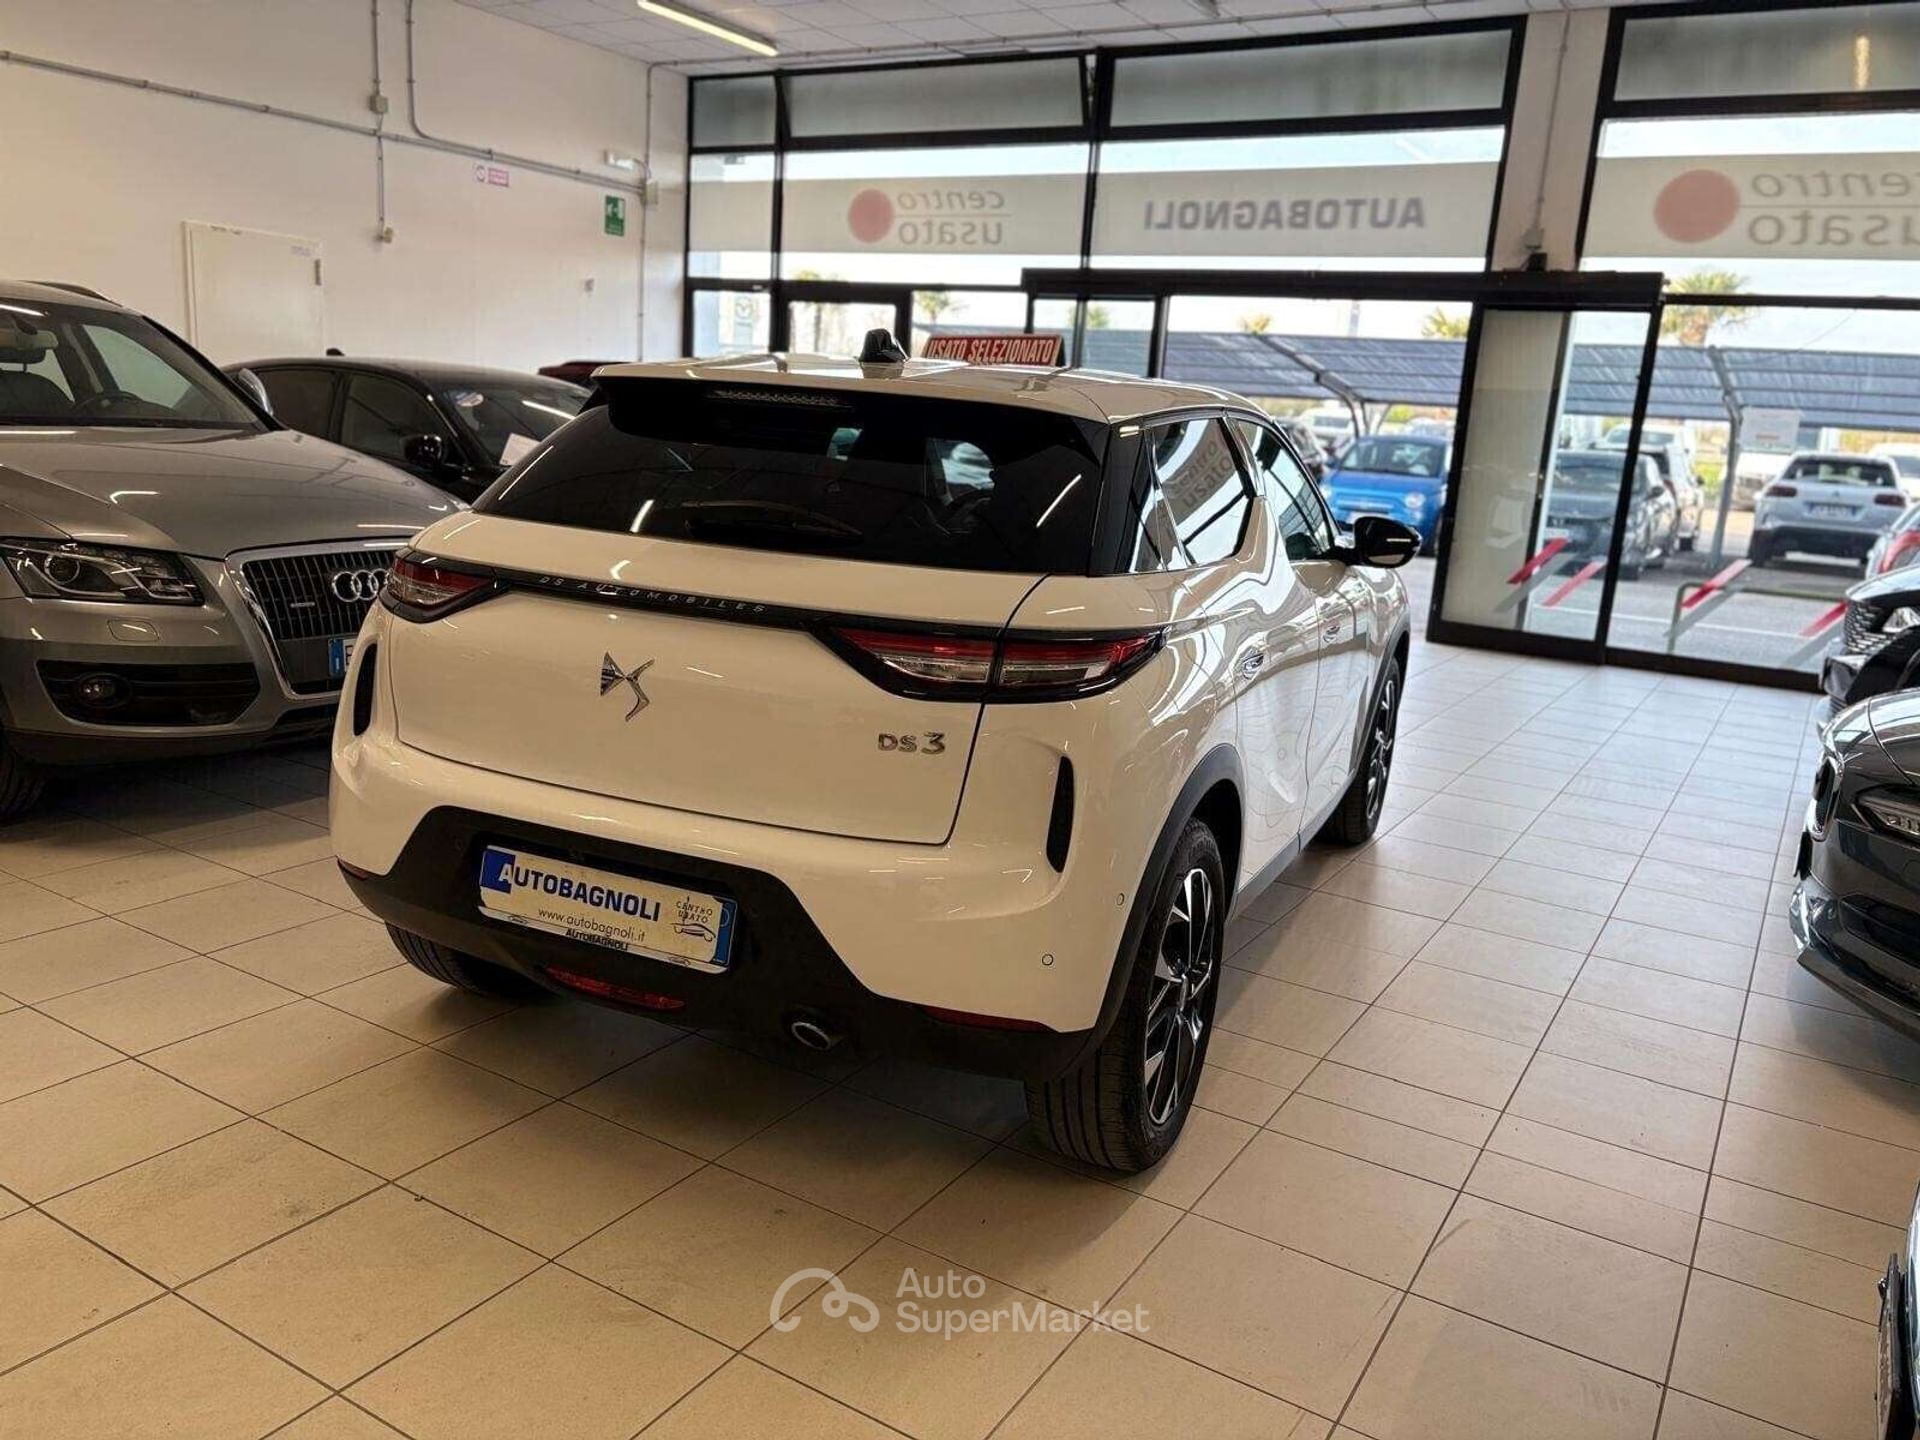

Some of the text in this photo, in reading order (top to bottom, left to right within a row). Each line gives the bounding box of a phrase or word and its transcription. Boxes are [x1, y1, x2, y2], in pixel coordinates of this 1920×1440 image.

[928, 338, 1054, 364] USATO SELEZIONATO
[538, 576, 766, 613] DS AUTOMOBILES
[498, 862, 662, 922] AUTOBAGNOLI
[537, 907, 646, 943] www.autobagnoli.it
